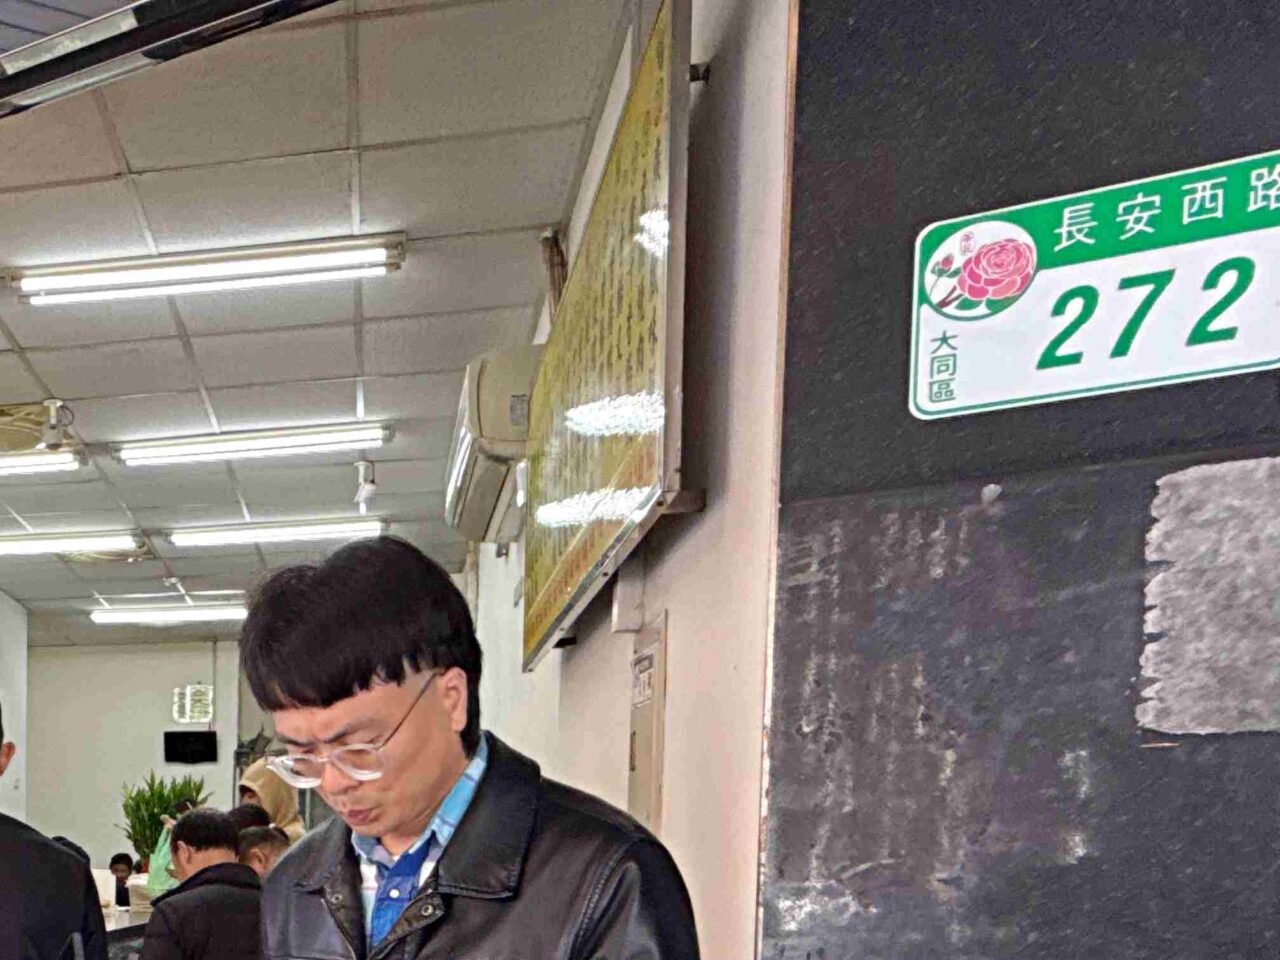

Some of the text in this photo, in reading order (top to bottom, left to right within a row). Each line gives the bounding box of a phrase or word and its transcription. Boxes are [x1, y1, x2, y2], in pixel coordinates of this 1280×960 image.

[1054, 164, 1280, 252] 長安西路
[1036, 256, 1256, 370] 272
[928, 330, 958, 403] 大同區
